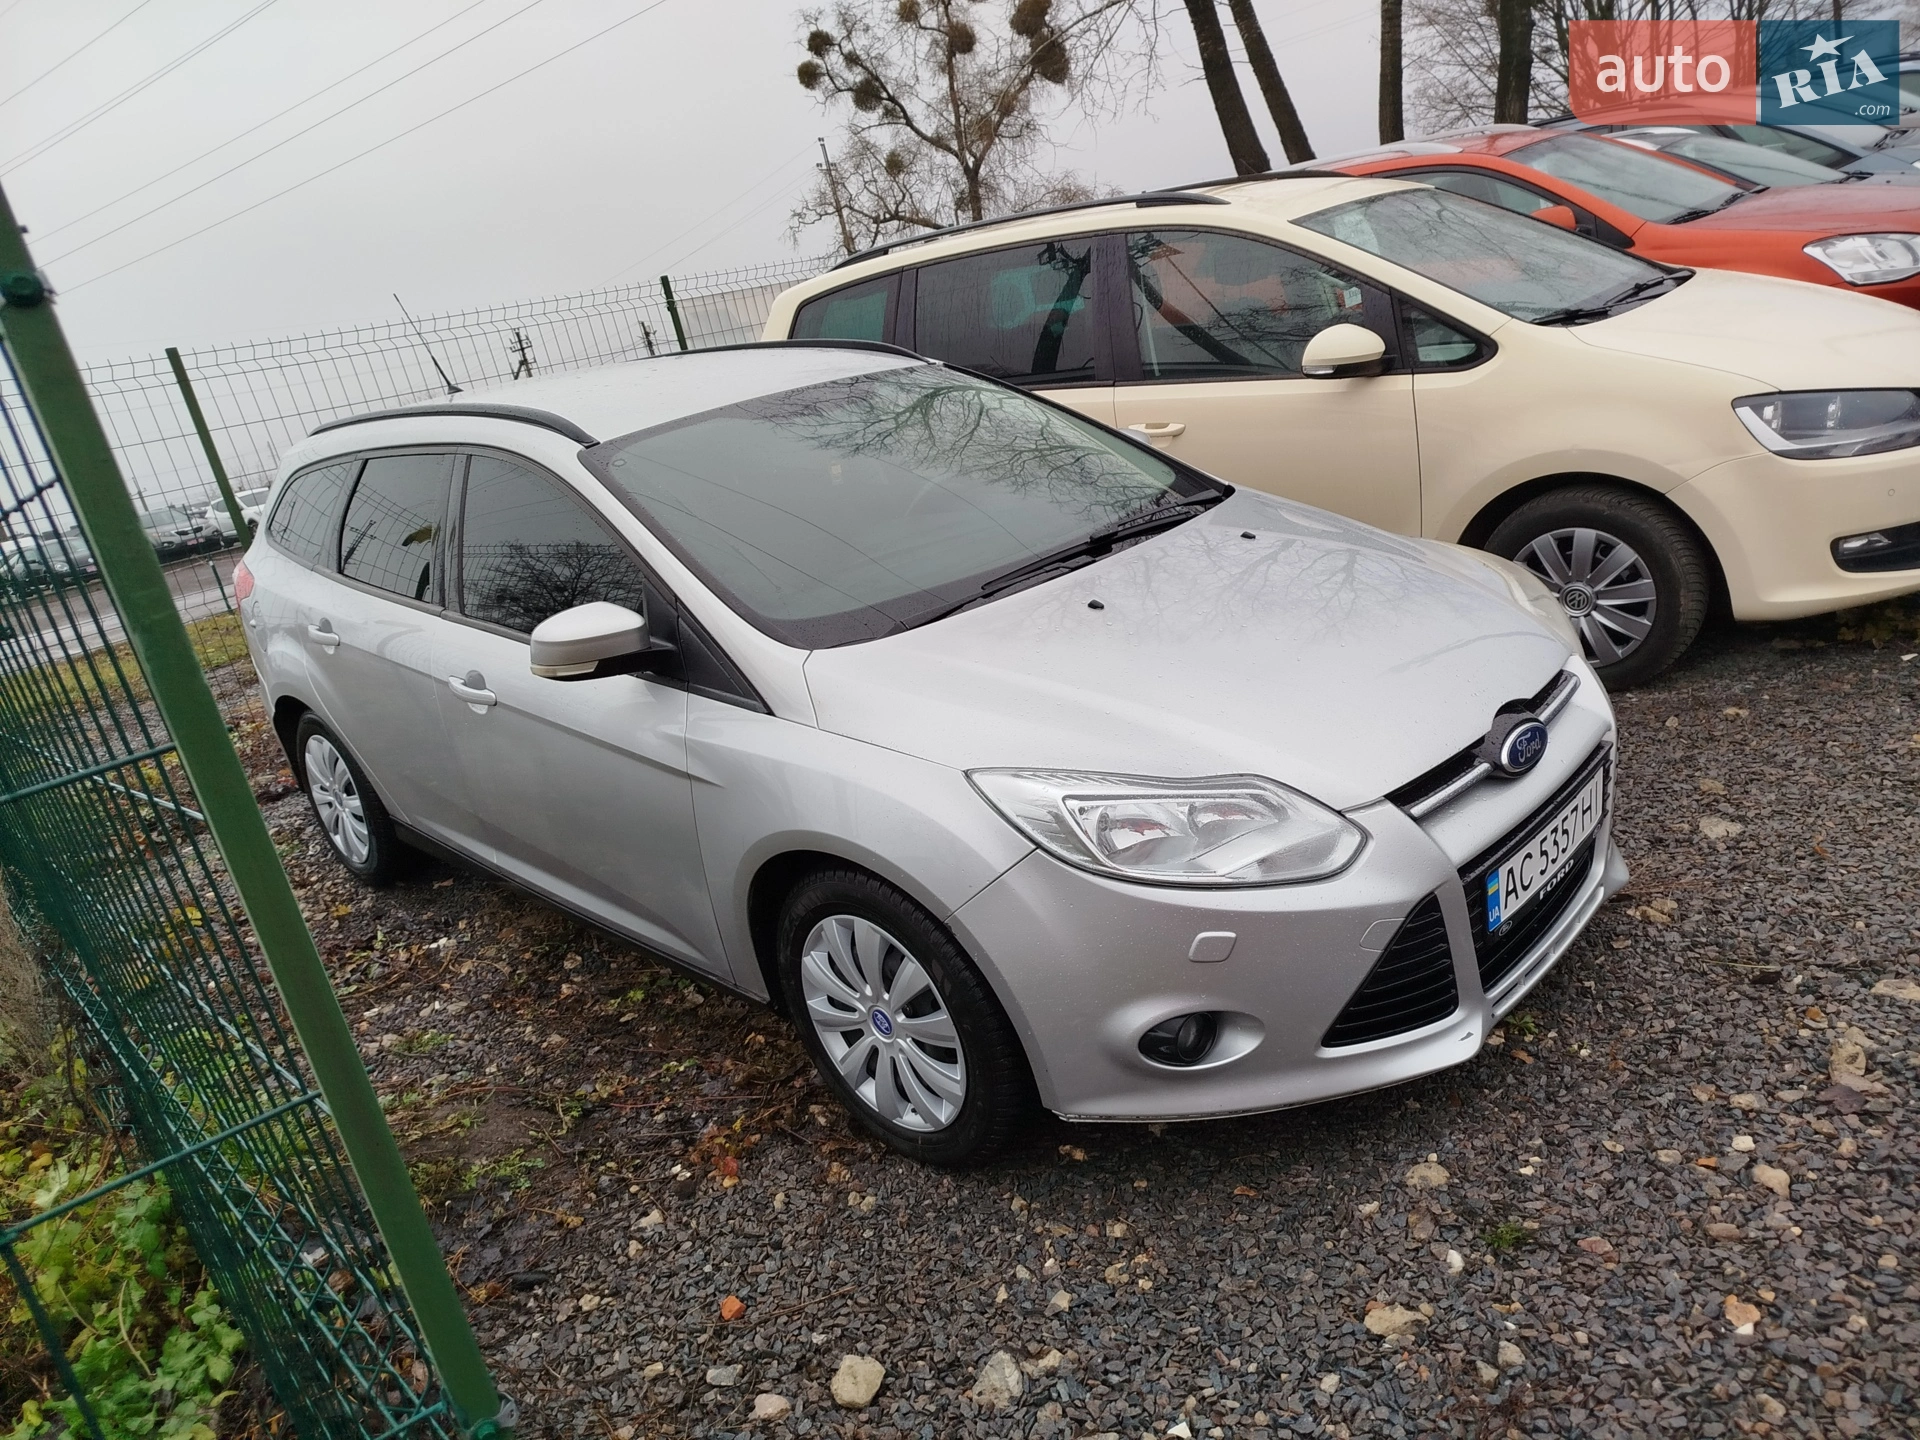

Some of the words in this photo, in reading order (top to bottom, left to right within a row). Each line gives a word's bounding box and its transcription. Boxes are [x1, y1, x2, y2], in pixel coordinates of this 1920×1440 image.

[1516, 731, 1541, 763] Ford
[1504, 851, 1533, 910] AC
[1539, 803, 1579, 876] 5357
[1581, 780, 1598, 833] HI
[1540, 859, 1574, 900] FORD
[1488, 906, 1500, 922] UA
